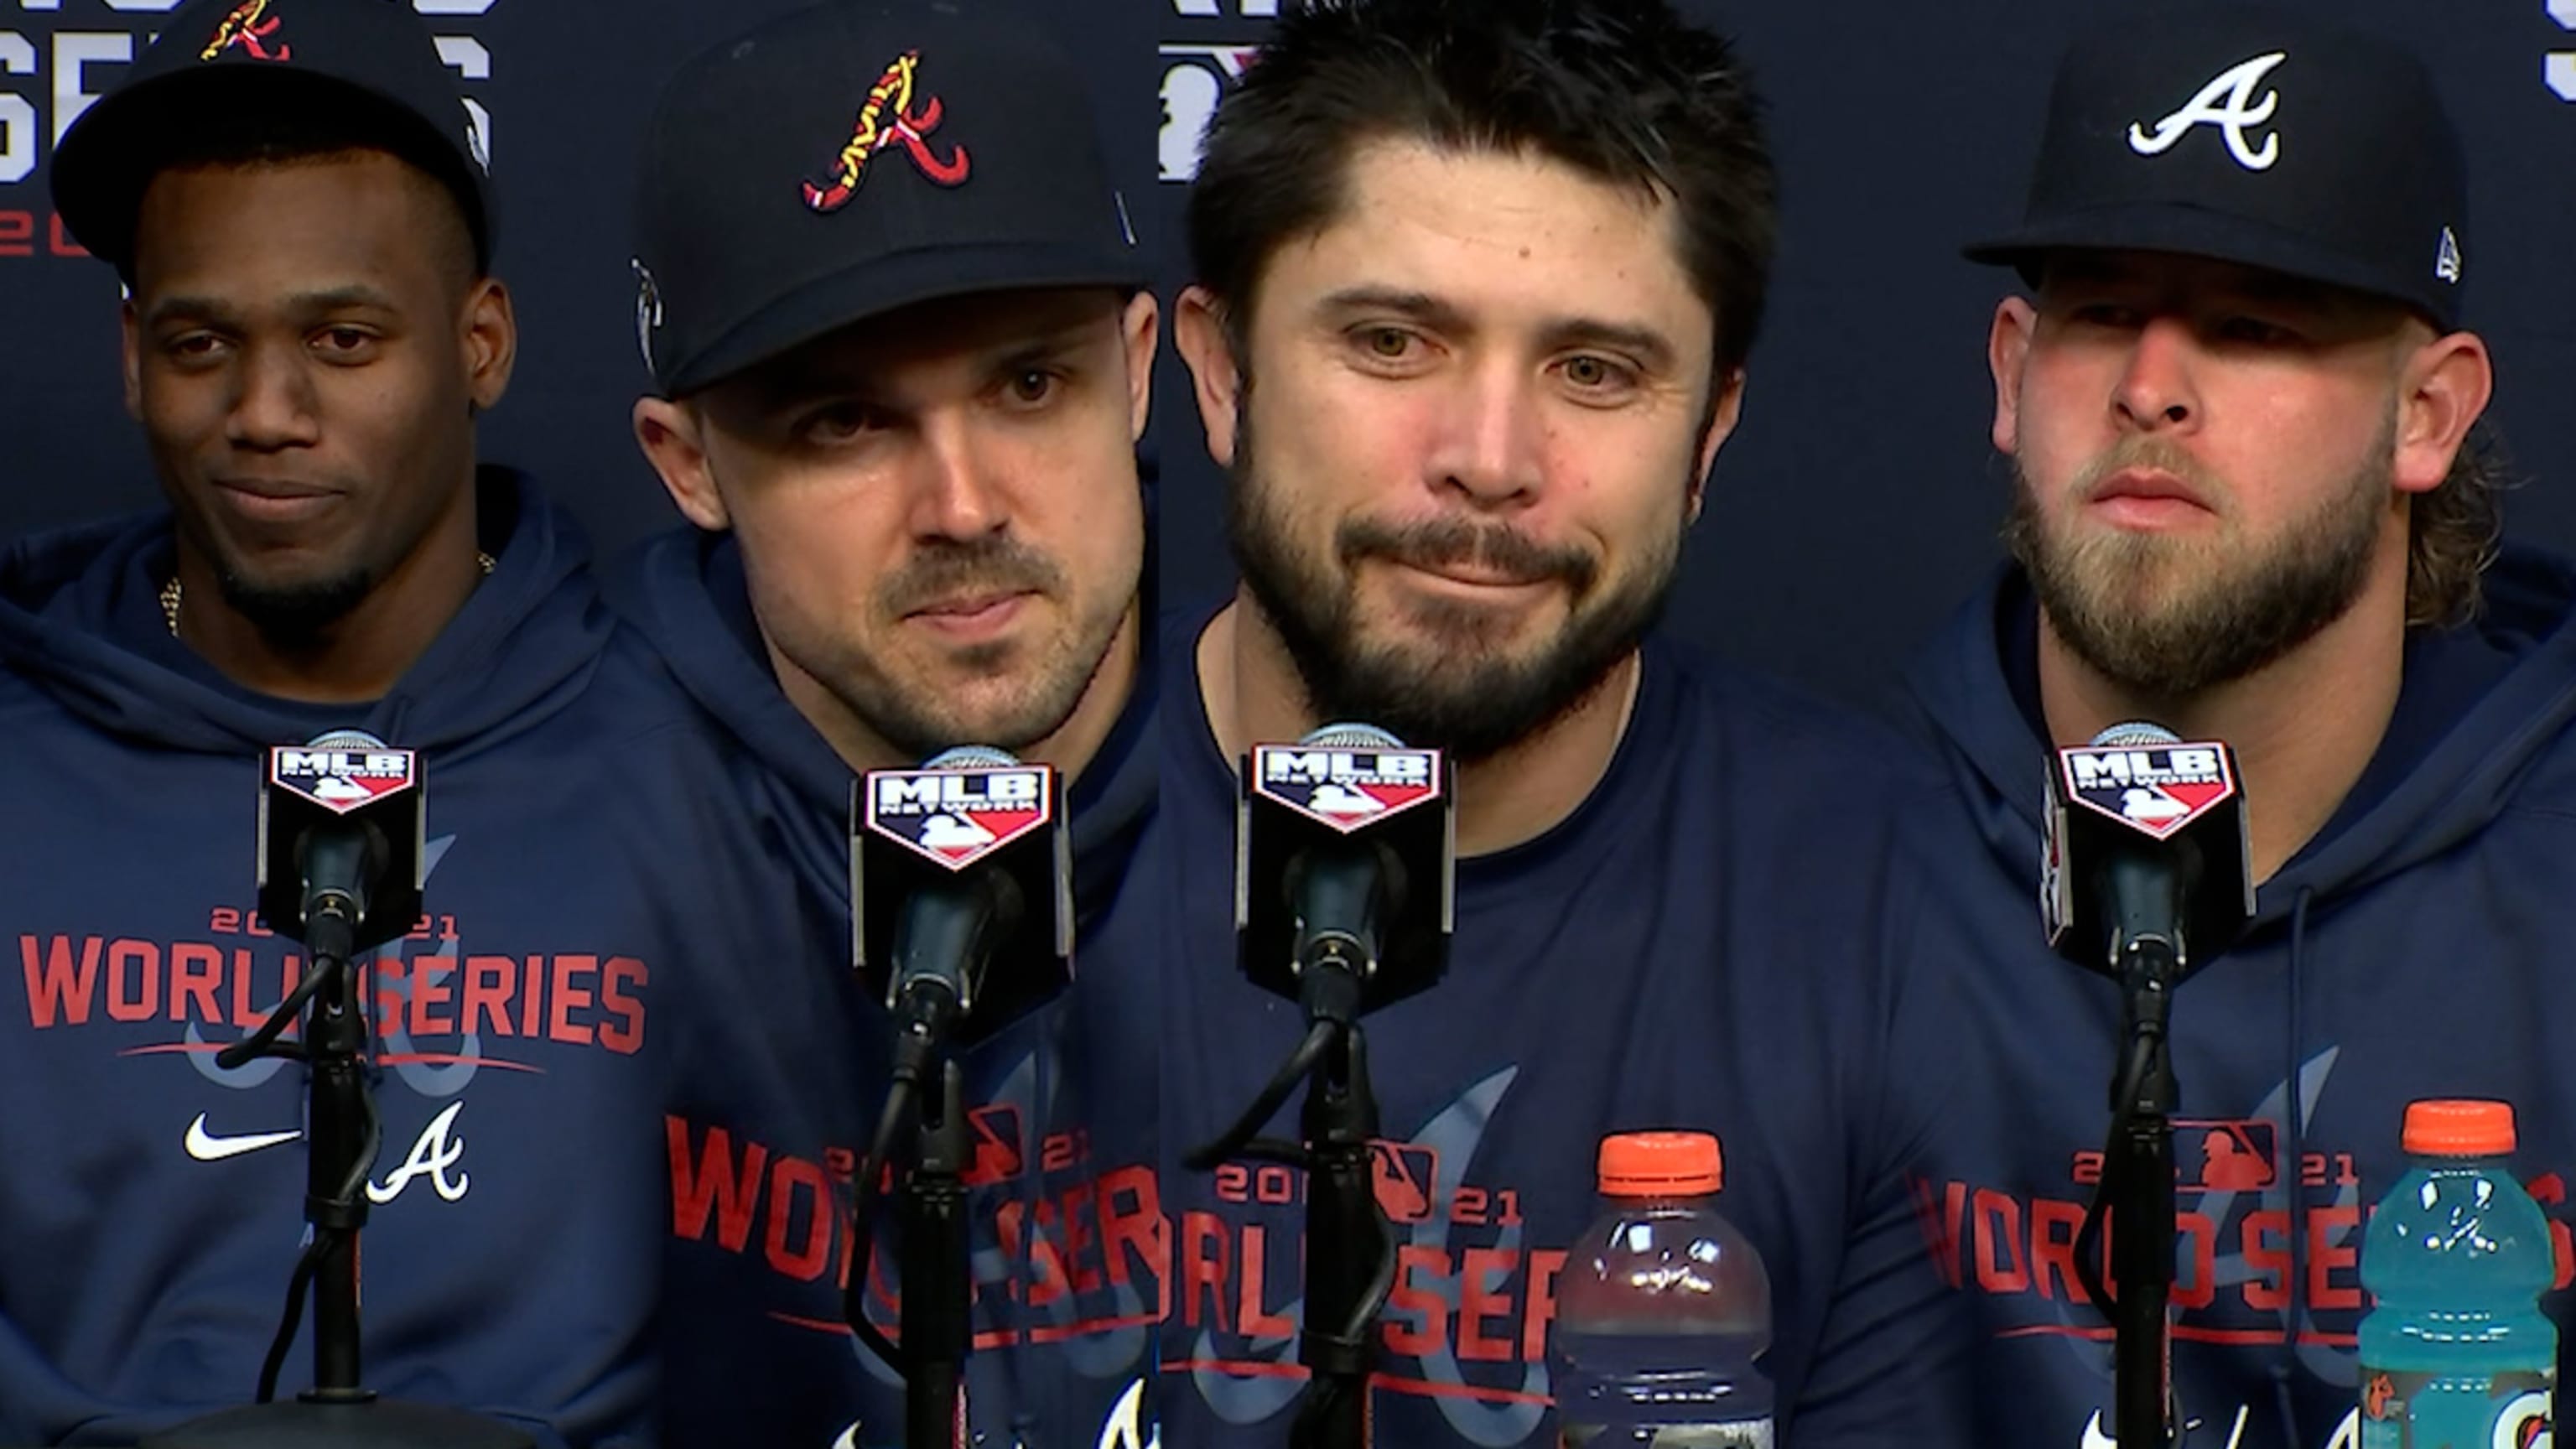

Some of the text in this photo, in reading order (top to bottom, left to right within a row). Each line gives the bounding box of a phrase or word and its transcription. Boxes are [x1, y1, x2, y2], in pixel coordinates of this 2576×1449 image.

[2129, 52, 2286, 169] A
[802, 50, 970, 210] A
[281, 751, 406, 772] MLB
[1266, 751, 1429, 776] MLB
[2071, 750, 2219, 777] MLB
[880, 773, 1038, 805] MLB
[1266, 773, 1427, 786] NETWORK
[2077, 773, 2221, 789] NETWORK
[880, 800, 1038, 815] NETWORK
[356, 953, 648, 1056] SERIES
[366, 1100, 468, 1204] A
[1216, 1164, 1293, 1203] 20
[2301, 1153, 2360, 1187] 21
[1450, 1190, 1522, 1226] 21
